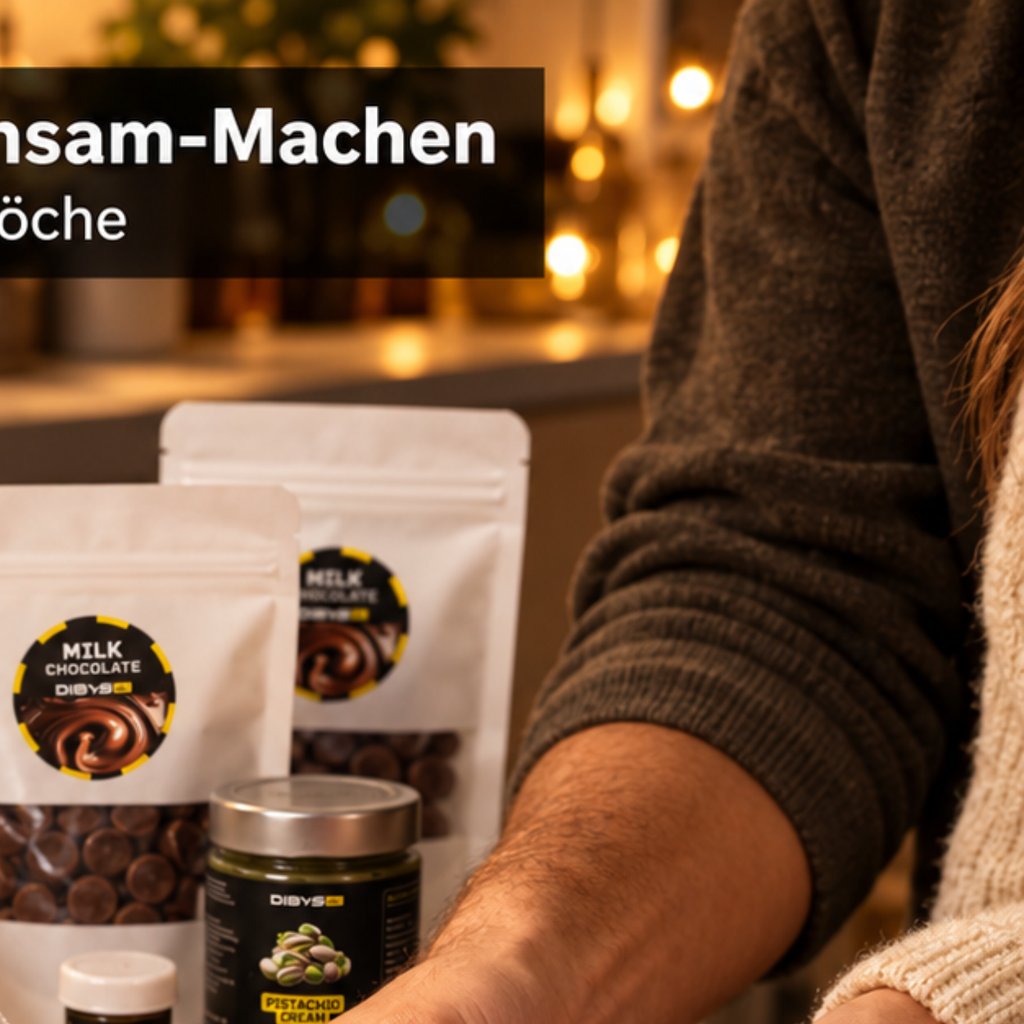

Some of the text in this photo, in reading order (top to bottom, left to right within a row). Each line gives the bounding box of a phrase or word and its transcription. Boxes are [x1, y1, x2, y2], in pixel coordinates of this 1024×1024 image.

[299, 588, 378, 604] HOCOLATE
[62, 640, 123, 660] MILK
[45, 660, 141, 676] CHOCOLATE
